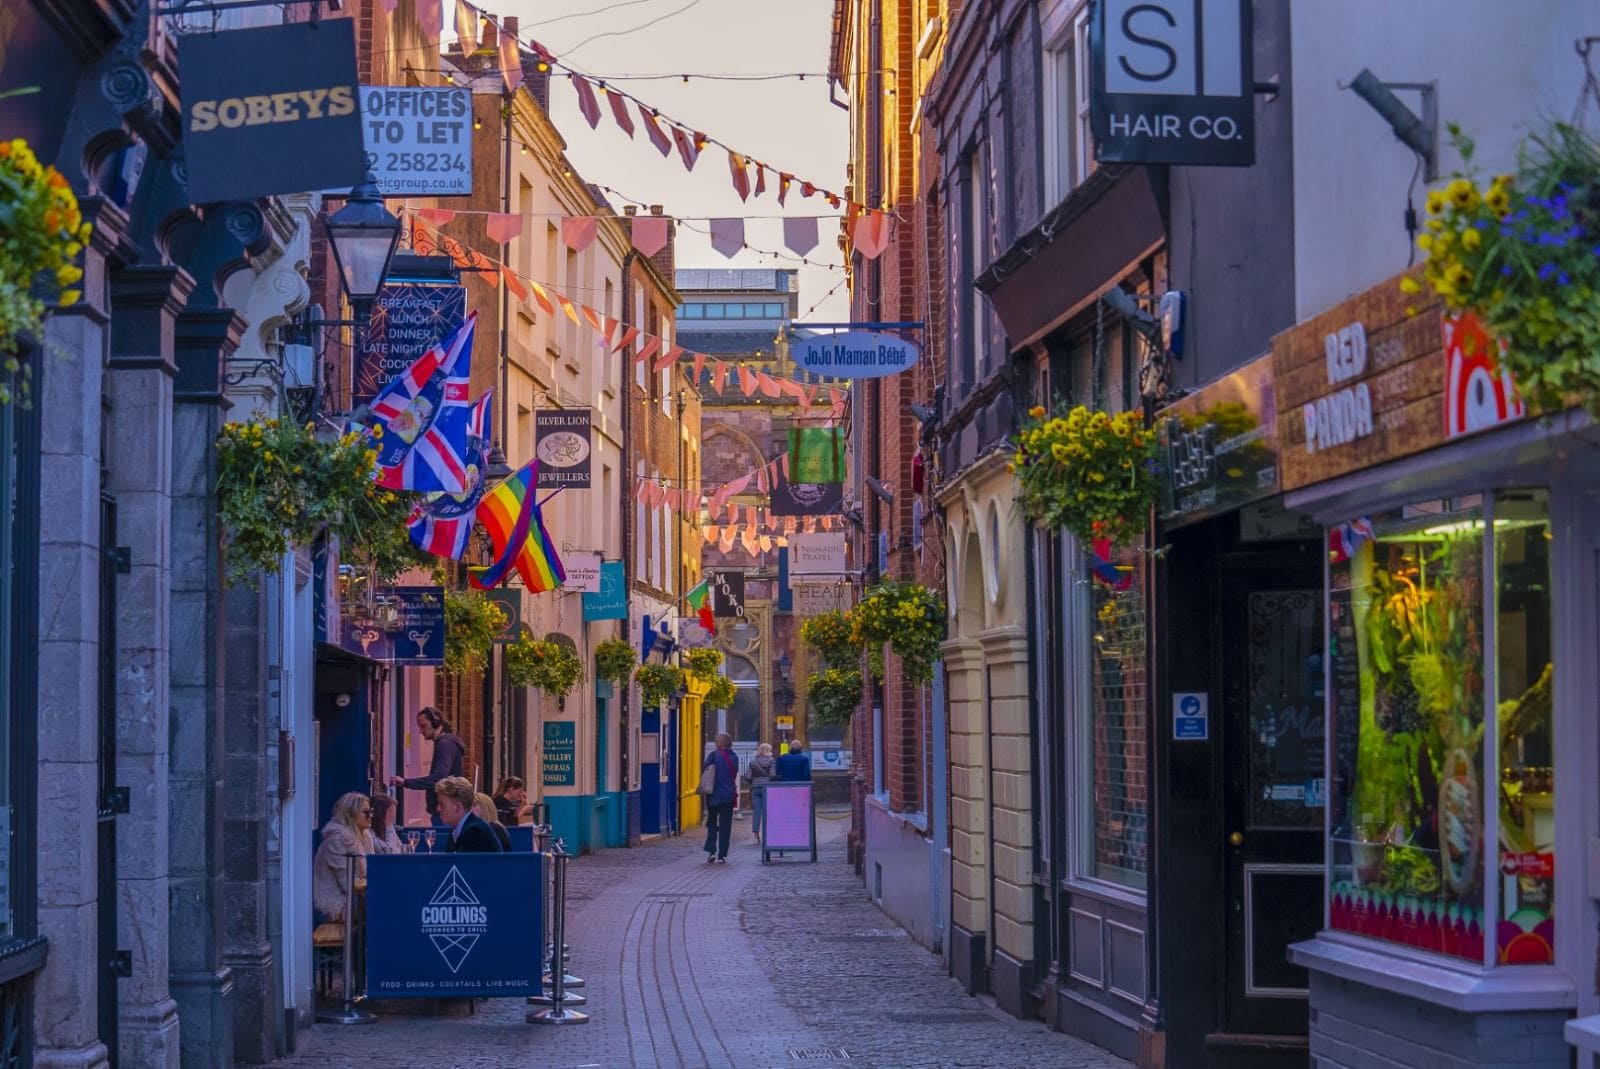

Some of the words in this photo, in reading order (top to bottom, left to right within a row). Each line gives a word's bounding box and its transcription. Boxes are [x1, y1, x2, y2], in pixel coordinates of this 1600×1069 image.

[190, 86, 355, 132] SOBEYS
[367, 90, 466, 117] OFFICES
[368, 121, 404, 144] TO
[417, 121, 464, 144] LET
[1110, 113, 1181, 138] HAIR
[1189, 115, 1242, 140] CO.
[386, 152, 466, 172] 258234
[381, 298, 441, 309] BREAKFAST
[391, 314, 430, 324] LUNCH
[388, 328, 431, 339] DINNER
[363, 344, 388, 354] LATE
[391, 344, 424, 354] NIGHT
[804, 345, 832, 365] JoJo
[834, 345, 876, 365] Maman
[878, 345, 906, 365] Bébé
[1325, 322, 1368, 385] RED
[537, 416, 566, 426] SILVER
[567, 416, 590, 425] LION
[1303, 382, 1373, 454] PANDA
[537, 473, 590, 484] JEWELLERS
[715, 573, 744, 617] MOKO
[799, 585, 845, 598] HEAD
[421, 906, 487, 924] COOLINGS
